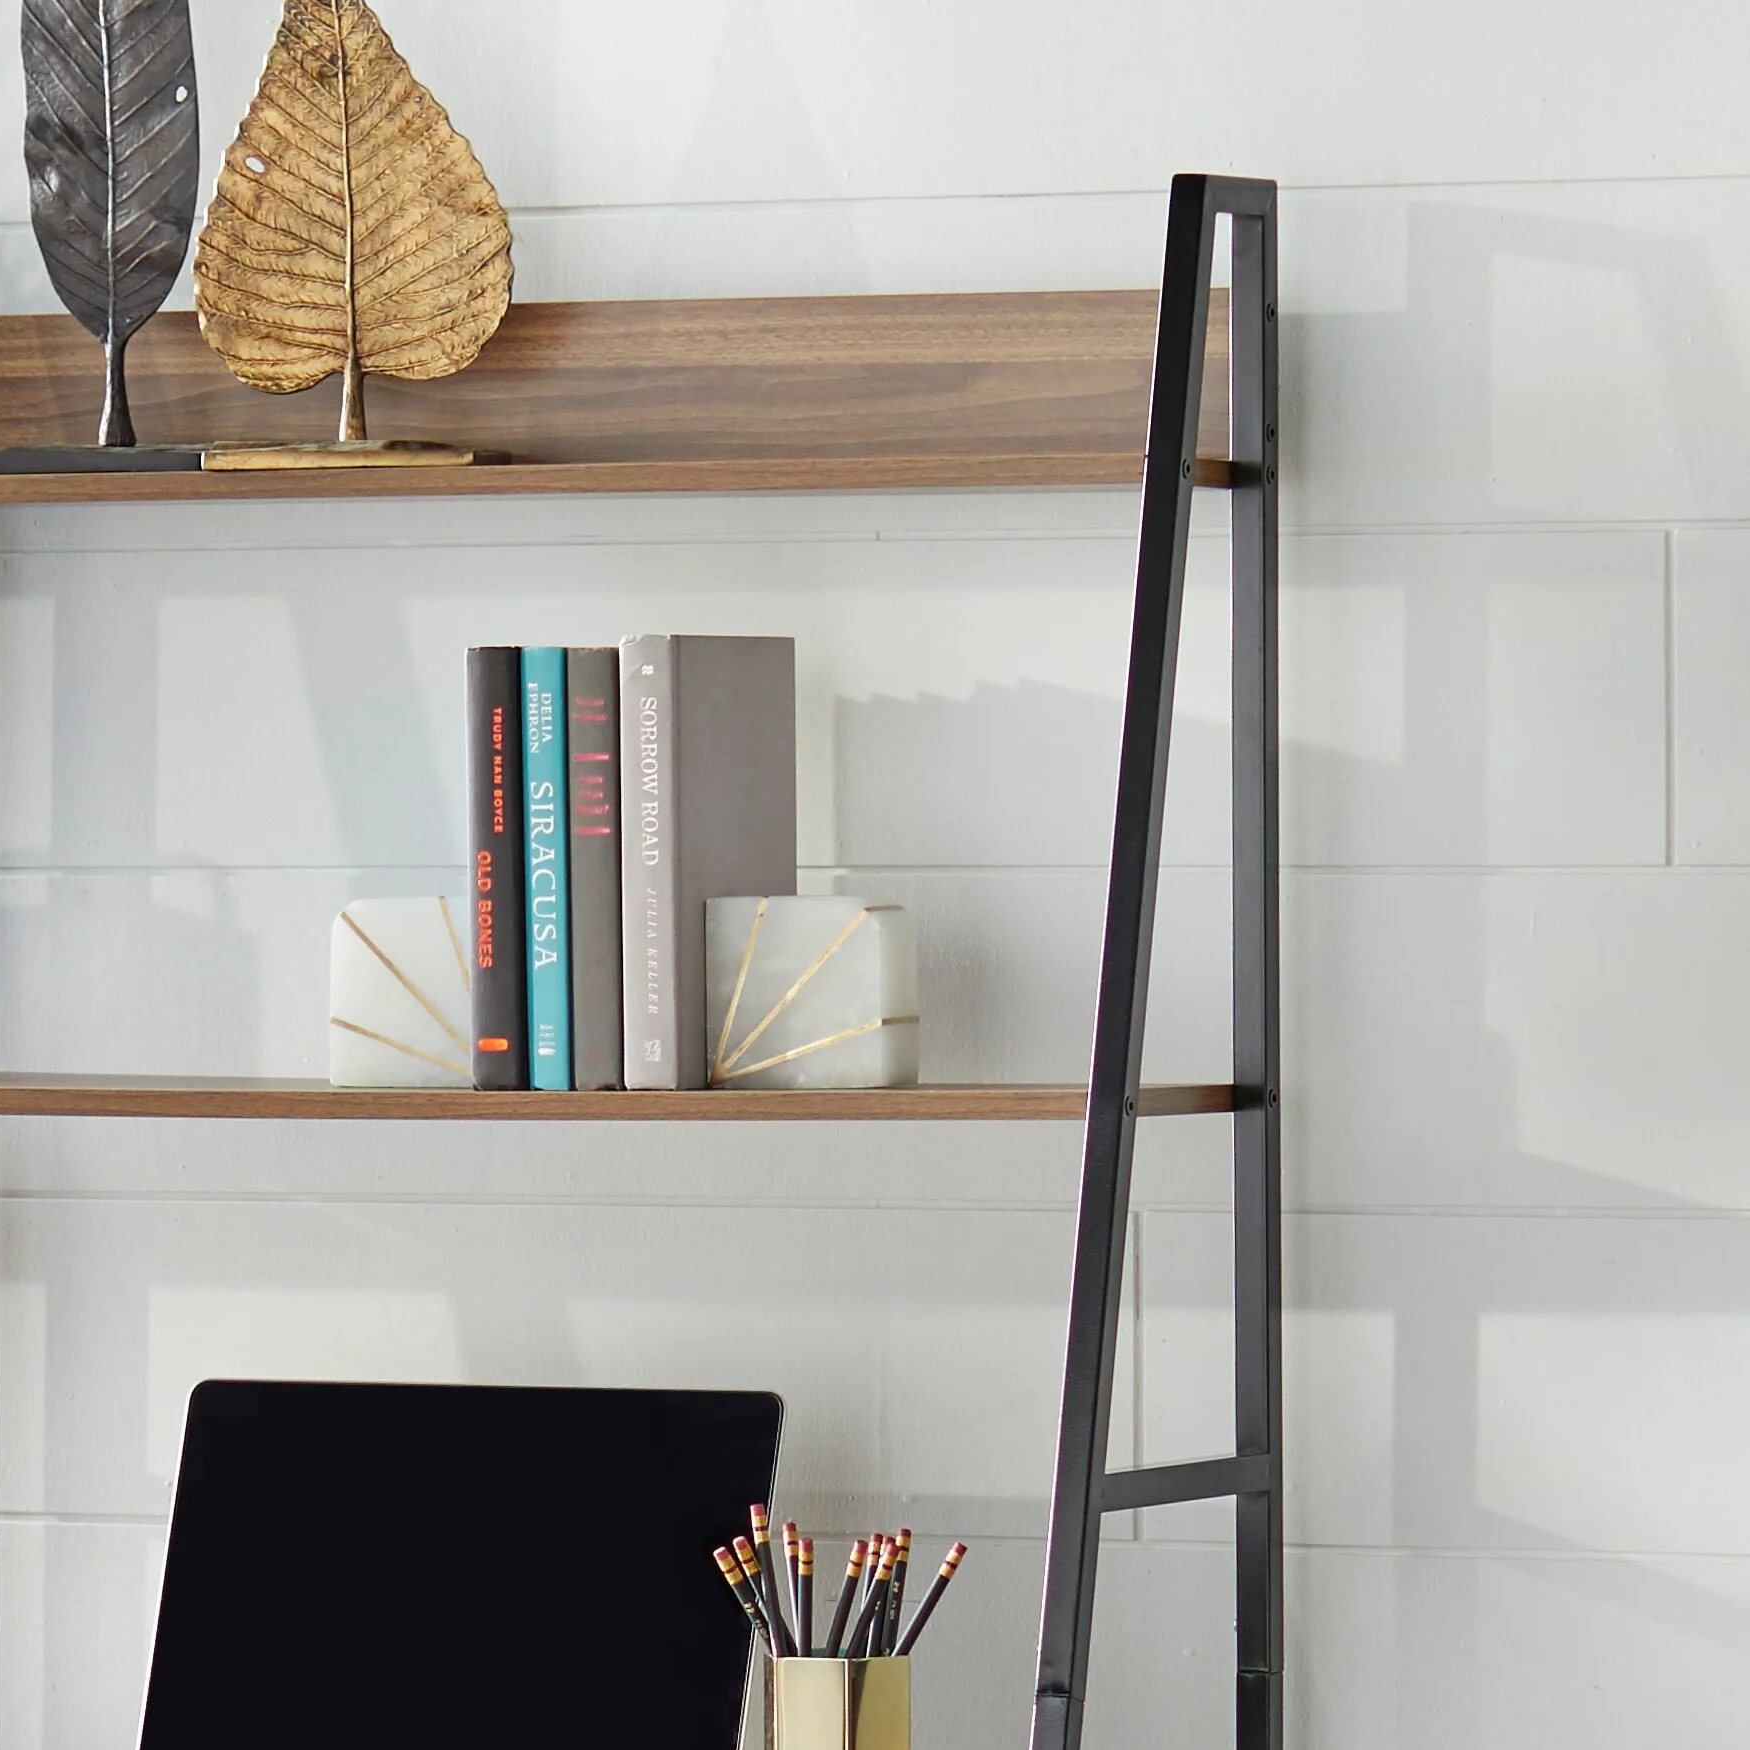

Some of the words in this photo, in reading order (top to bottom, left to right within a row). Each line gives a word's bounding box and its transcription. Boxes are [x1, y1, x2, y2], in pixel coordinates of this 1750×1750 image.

[493, 707, 503, 750] TRUDY
[527, 682, 540, 754] EPHRON
[540, 693, 553, 743] DELIA
[640, 696, 659, 796] SORROW
[493, 789, 504, 833] BOYCE
[641, 801, 660, 867] ROAD
[476, 850, 492, 892] OLD
[529, 781, 558, 971] SIRACUSA
[477, 900, 493, 969] BONES
[646, 888, 658, 938] JULIA
[647, 947, 659, 1014] KELLER
